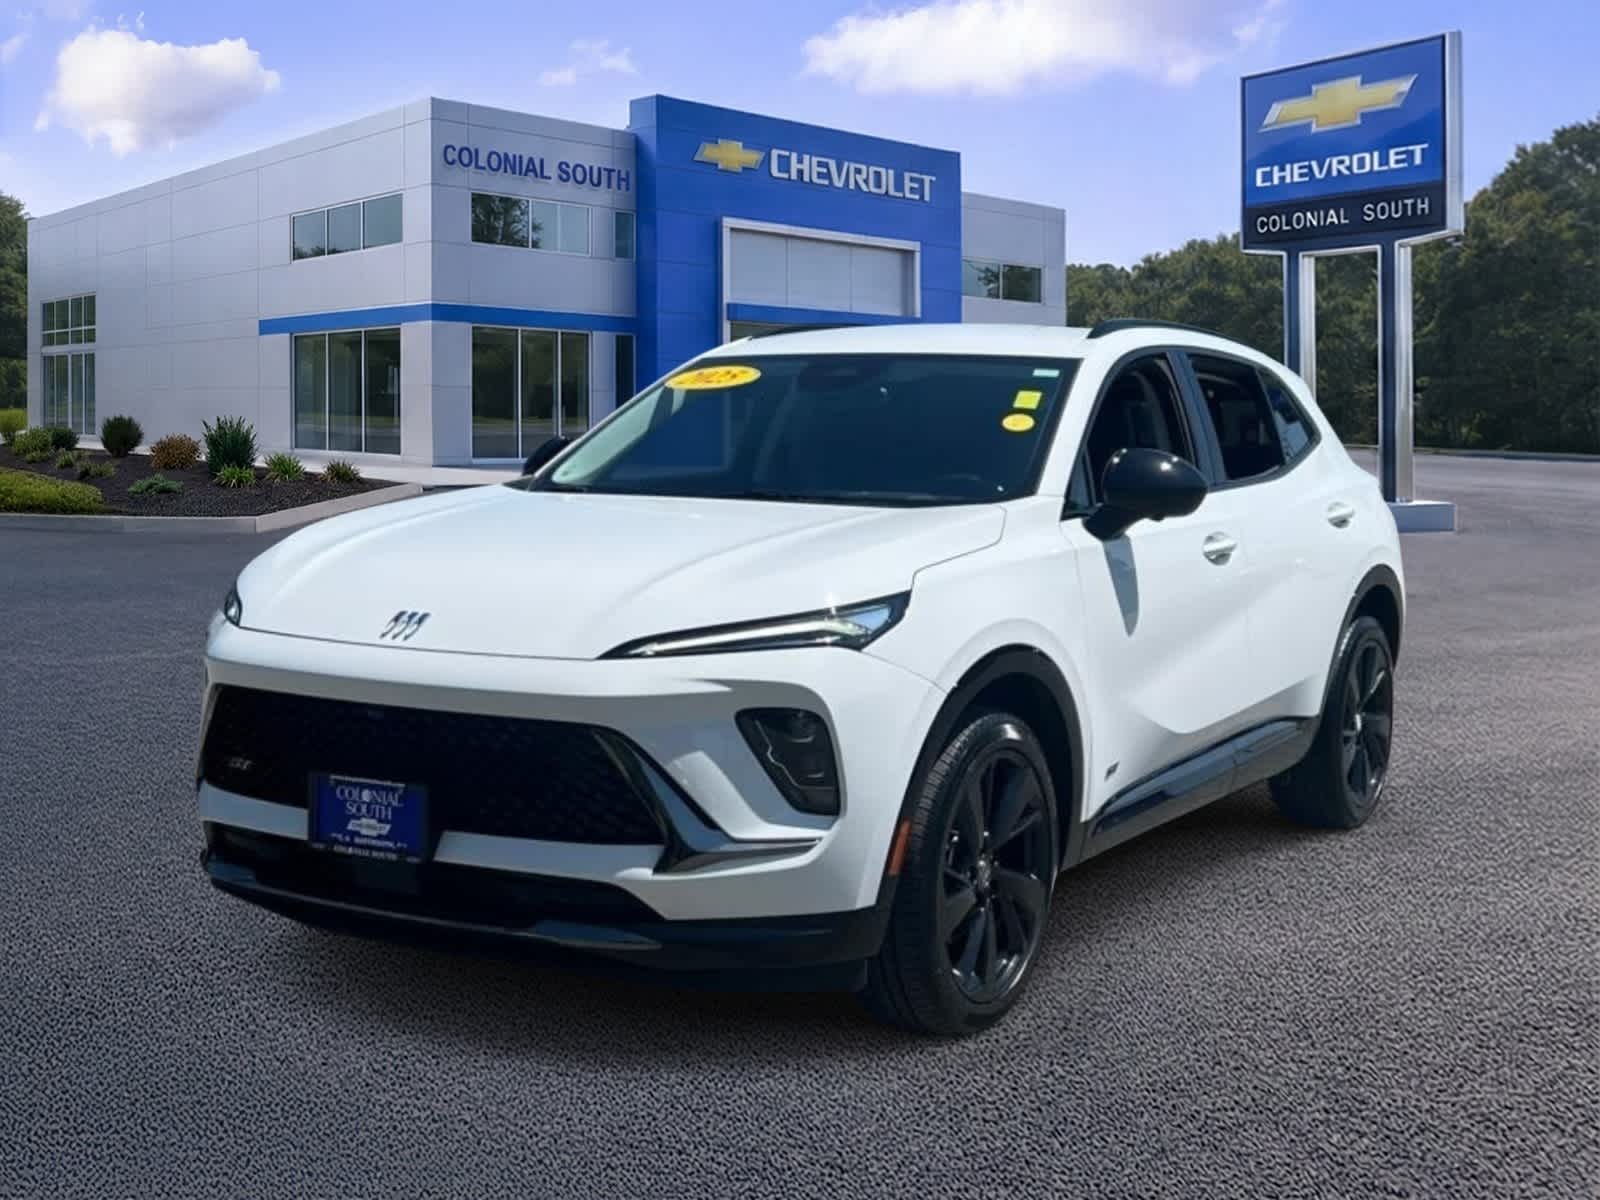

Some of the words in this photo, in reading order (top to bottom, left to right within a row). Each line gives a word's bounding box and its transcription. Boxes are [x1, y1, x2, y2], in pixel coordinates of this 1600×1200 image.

[443, 144, 552, 180] COLONIAL
[557, 161, 630, 191] SOUTH
[770, 148, 936, 202] CHEVROLET
[1255, 143, 1429, 188] CHEVROLET
[1256, 208, 1349, 234] COLONIAL
[1362, 197, 1430, 222] SOUTH
[345, 801, 392, 820] SOUTH
